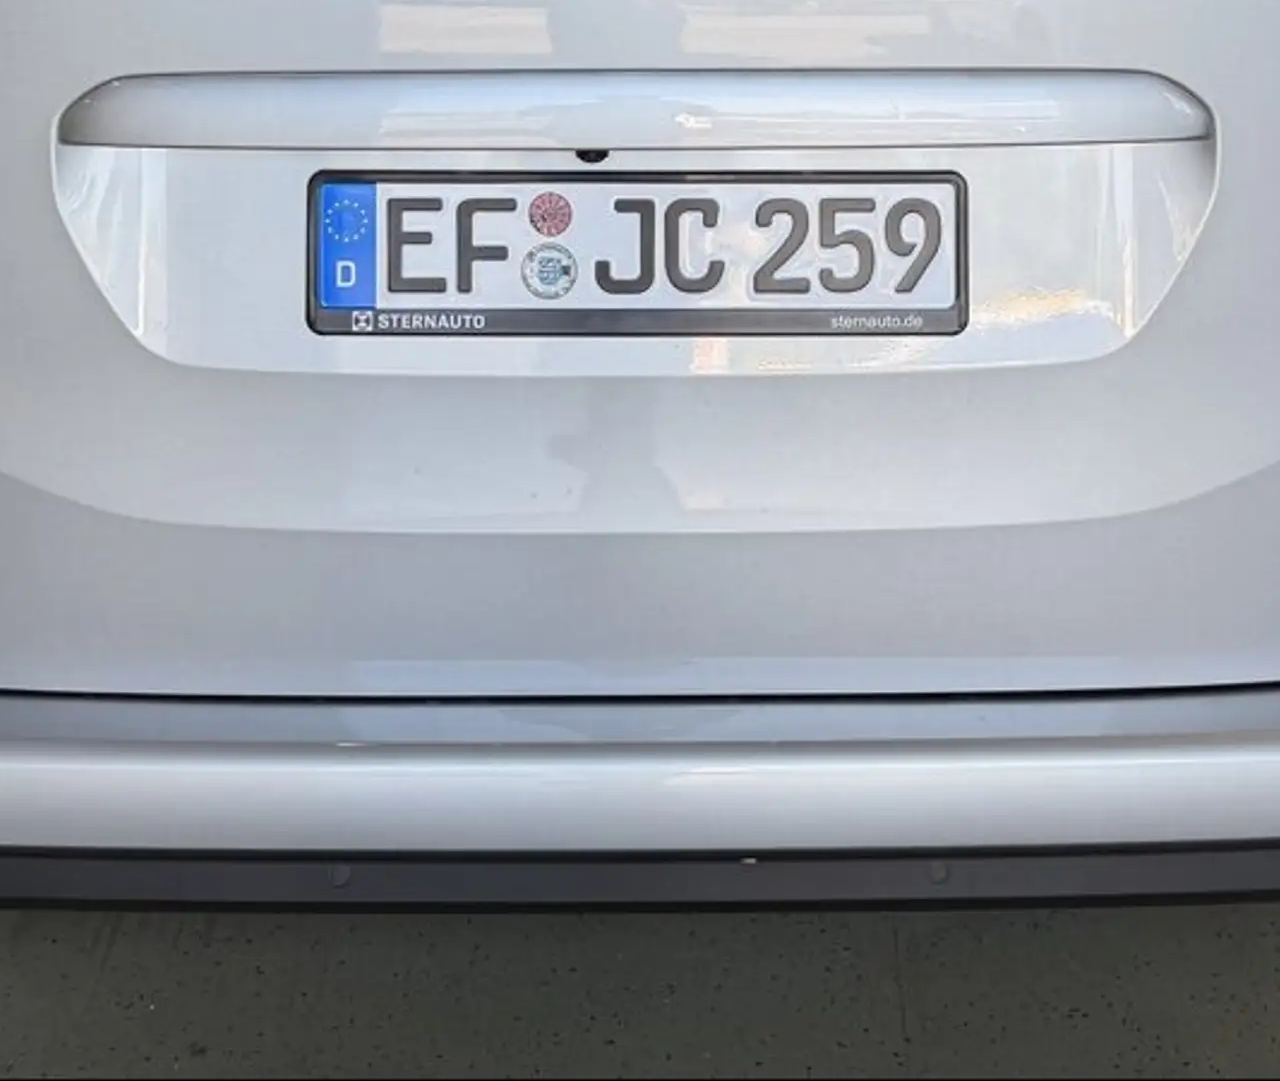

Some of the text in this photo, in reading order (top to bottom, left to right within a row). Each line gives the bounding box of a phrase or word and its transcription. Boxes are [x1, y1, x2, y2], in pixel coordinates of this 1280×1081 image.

[386, 197, 518, 293] EF
[594, 197, 725, 295] JC
[752, 197, 942, 294] 259
[335, 260, 357, 289] D
[377, 314, 486, 330] STERNAUTO
[831, 314, 924, 329] sternauto.de
